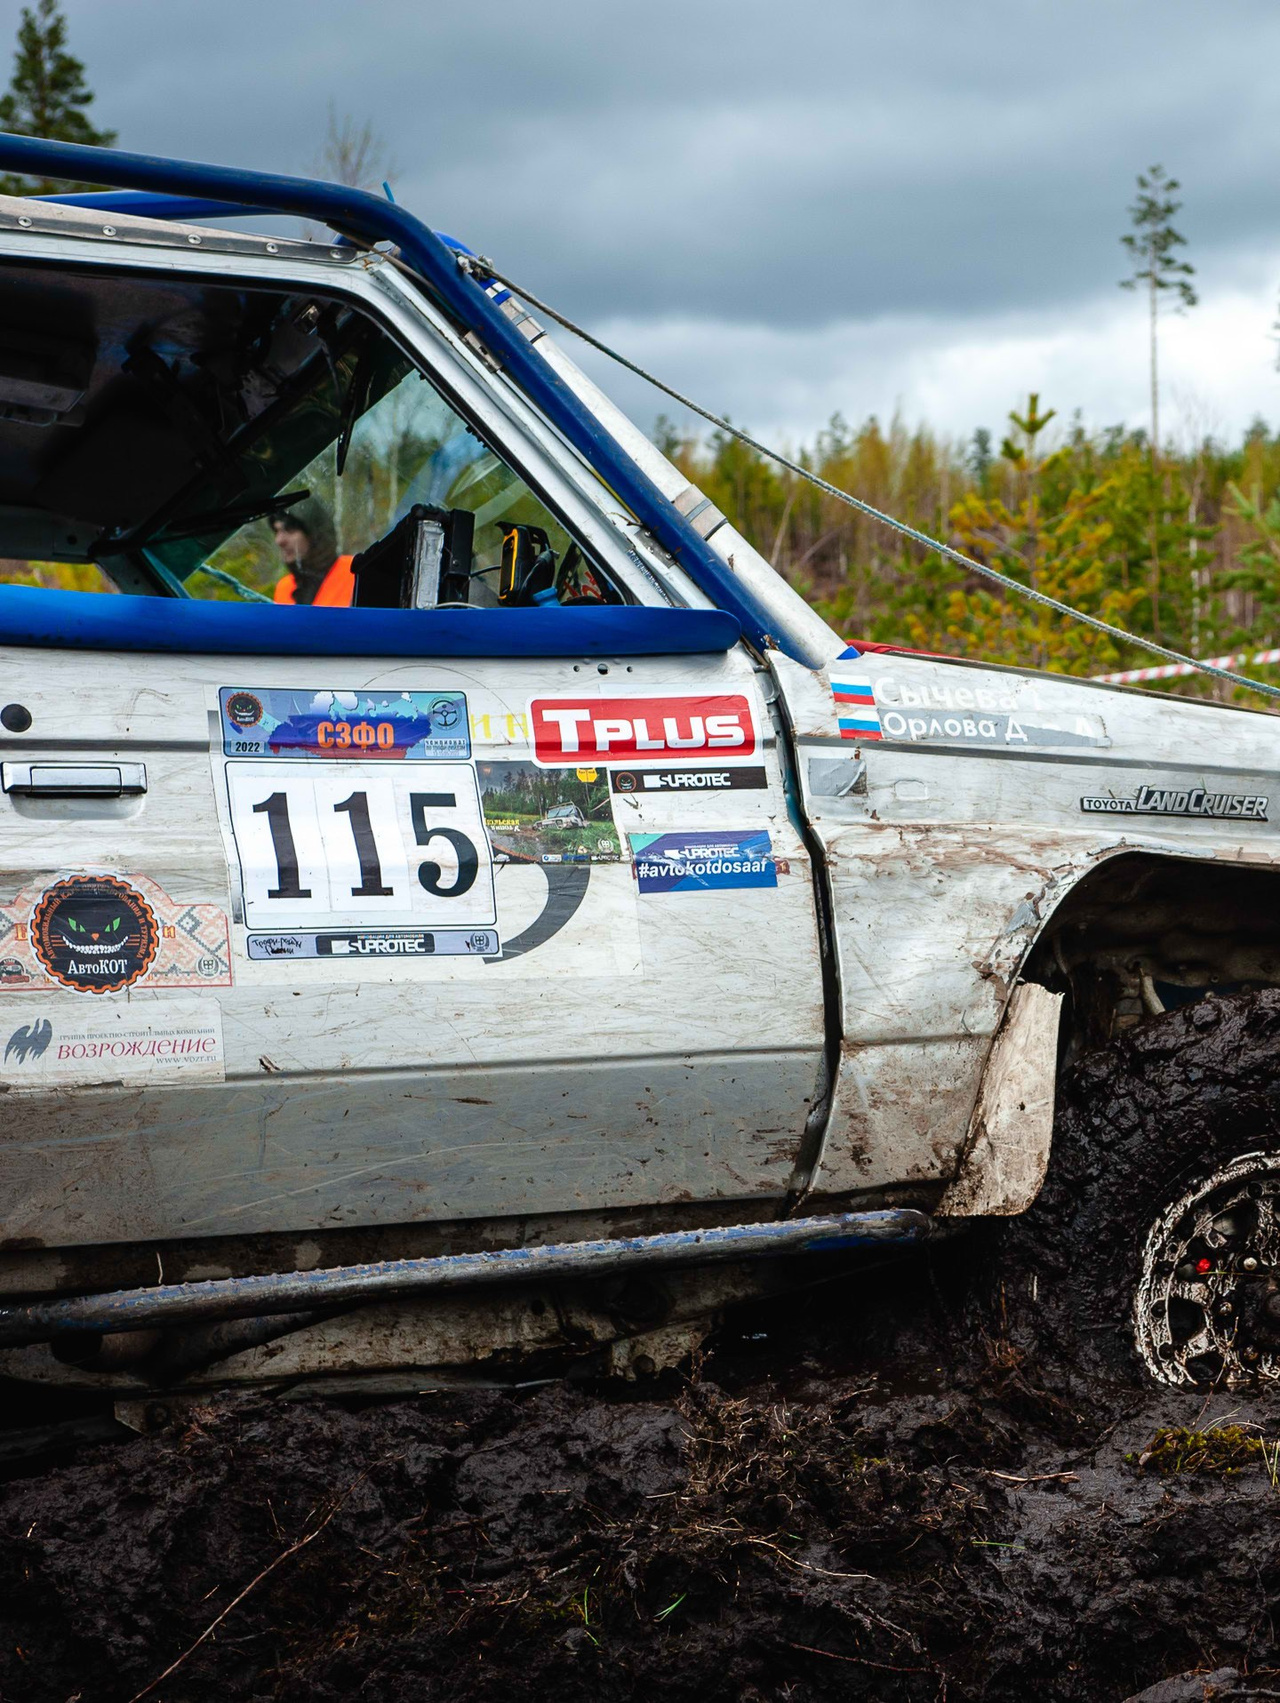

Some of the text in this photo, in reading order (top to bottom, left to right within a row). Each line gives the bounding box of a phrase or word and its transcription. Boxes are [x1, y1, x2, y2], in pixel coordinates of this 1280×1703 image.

[317, 721, 394, 750] СЗФО
[541, 709, 746, 753] TPLUS
[882, 711, 996, 742] Орлова
[235, 742, 260, 753] 2022
[660, 773, 732, 787] SUPROTEC
[1086, 799, 1133, 811] TOYOTA
[252, 791, 479, 898] 115
[680, 847, 740, 860] SUPROTEC
[638, 859, 768, 879] #avtokotdosaaf
[348, 938, 426, 954] SUPROTEC
